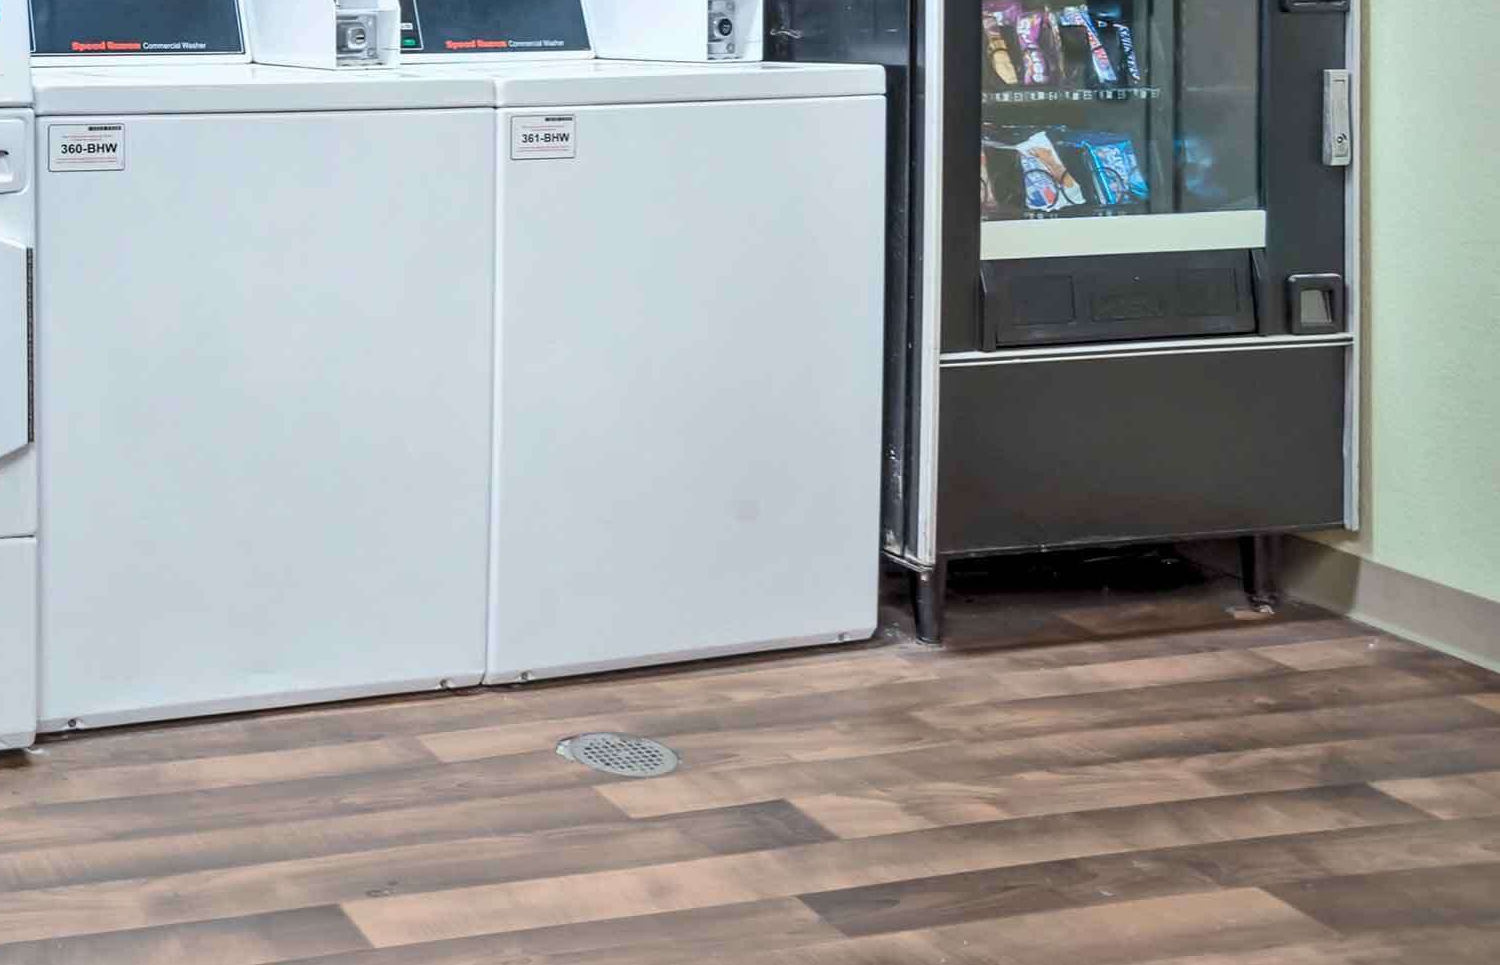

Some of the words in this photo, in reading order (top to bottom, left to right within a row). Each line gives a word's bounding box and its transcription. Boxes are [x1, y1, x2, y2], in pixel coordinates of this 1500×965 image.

[71, 41, 106, 51] Speed
[142, 41, 181, 50] Commercial
[182, 41, 206, 50] Washer
[445, 40, 476, 49] Speed
[508, 39, 542, 48] Commercial
[522, 133, 570, 143] 361-BHW
[61, 143, 118, 154] 360-BHW
